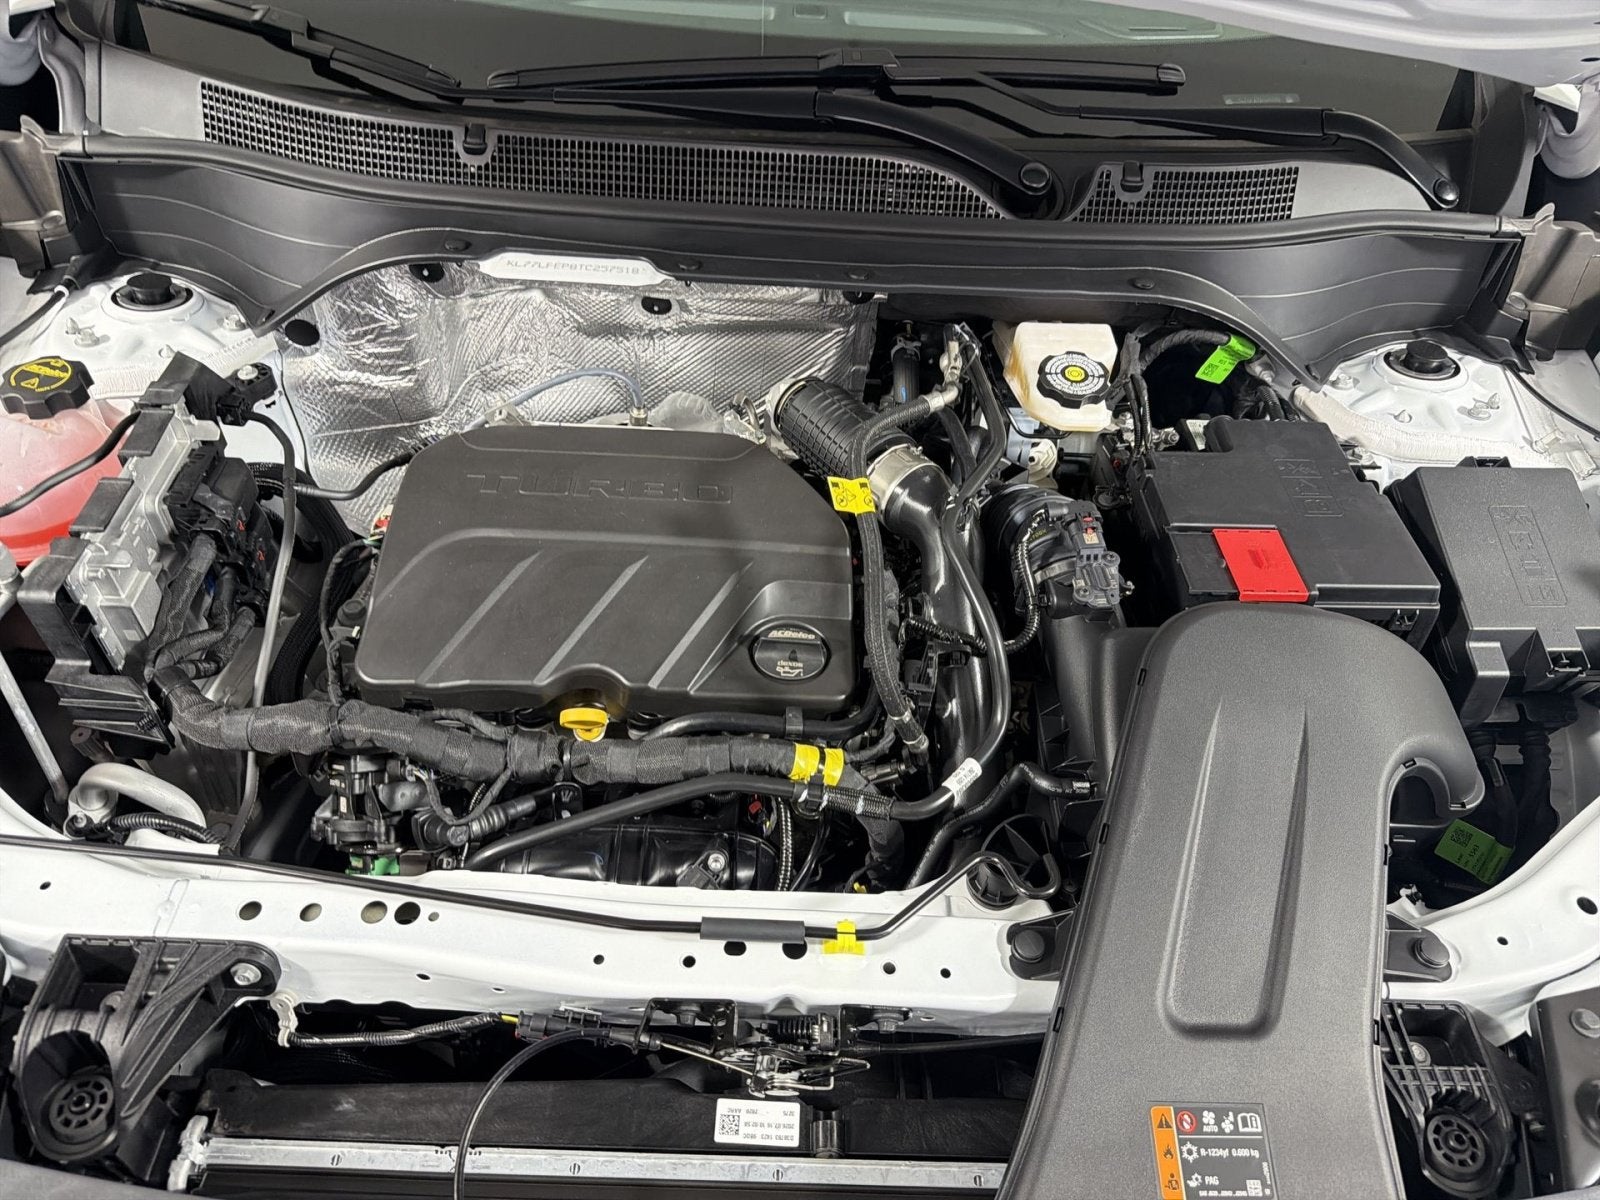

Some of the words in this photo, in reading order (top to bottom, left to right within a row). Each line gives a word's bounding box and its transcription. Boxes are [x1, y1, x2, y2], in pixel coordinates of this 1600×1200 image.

[466, 471, 733, 504] TURBO
[768, 630, 815, 640] ACDelco
[1251, 1149, 1260, 1159] kg
[1204, 1176, 1219, 1185] PAG
